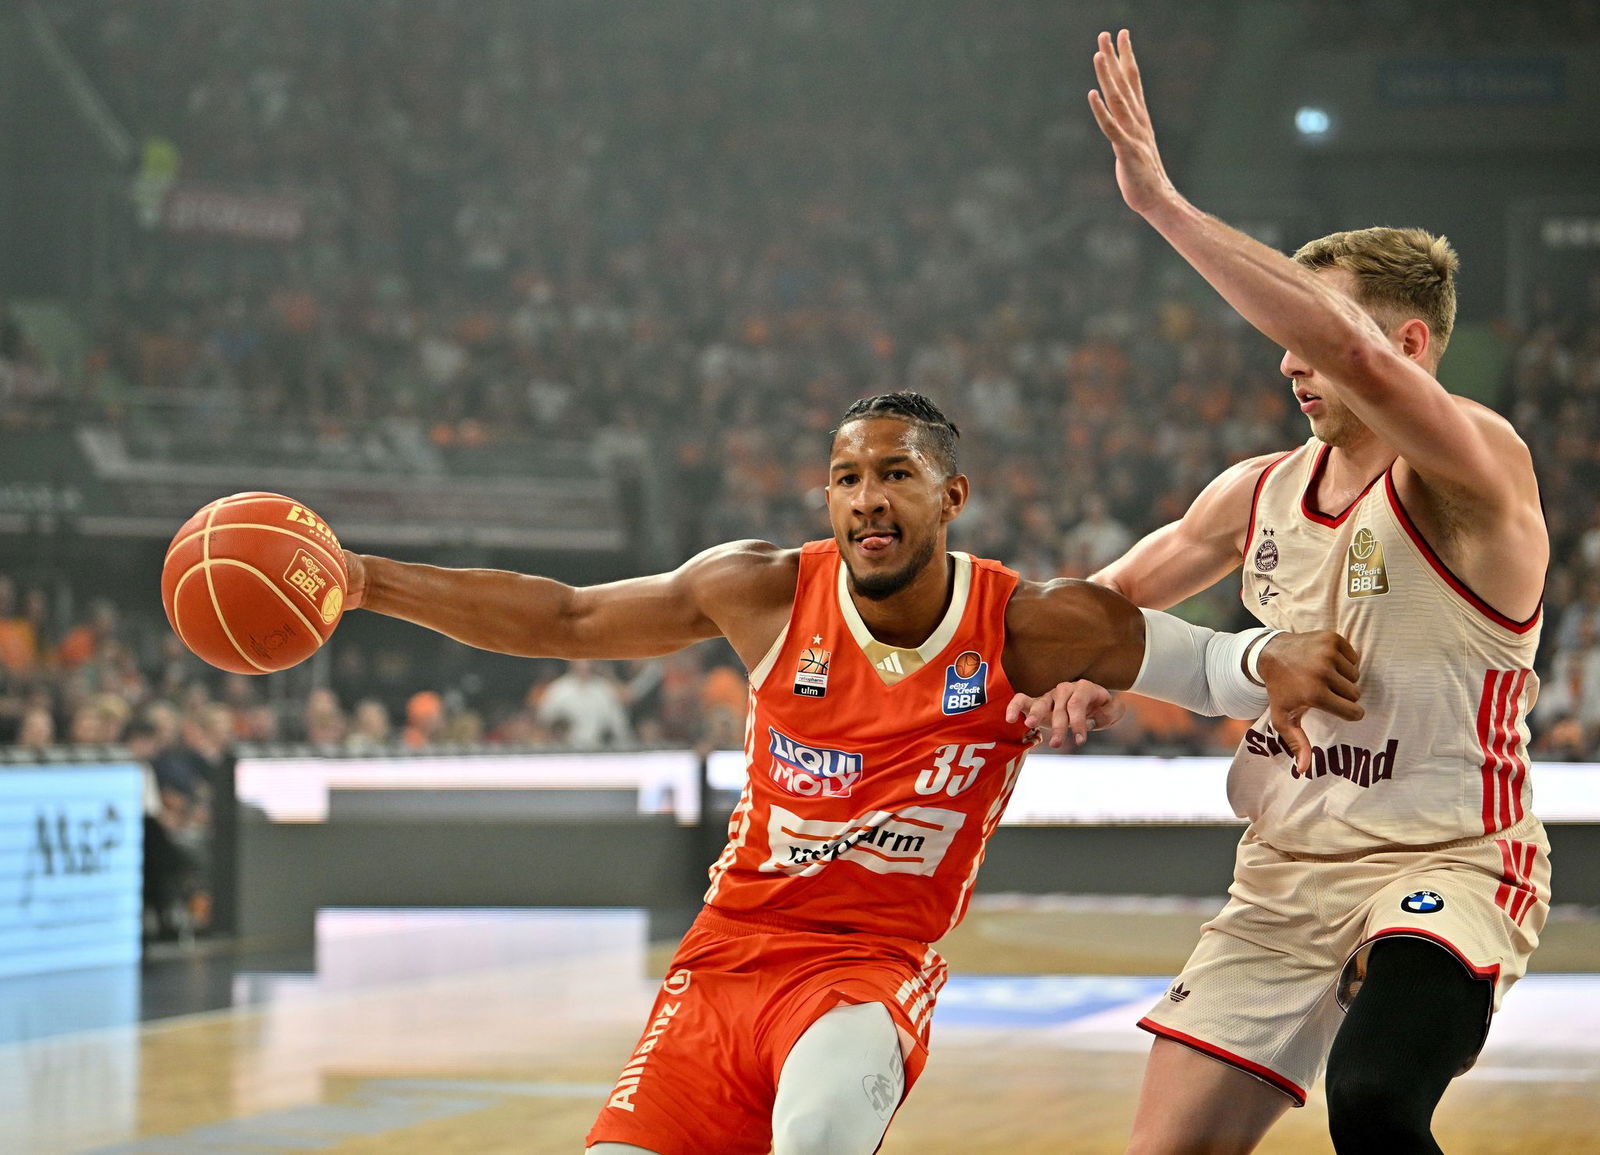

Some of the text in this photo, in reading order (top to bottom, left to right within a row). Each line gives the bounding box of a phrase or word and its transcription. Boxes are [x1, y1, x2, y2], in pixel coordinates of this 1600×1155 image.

[301, 556, 320, 573] easy
[1358, 567, 1382, 577] Credit
[290, 568, 320, 601] BBL
[307, 568, 327, 588] Credit
[1351, 576, 1384, 593] BBL
[801, 687, 818, 696] ulm
[949, 682, 969, 690] easy
[957, 686, 981, 695] Credit
[947, 694, 981, 709] BBL
[773, 732, 856, 777] LIQUI
[914, 741, 997, 797] 35
[773, 760, 860, 797] MOLY
[1408, 891, 1442, 901] BMW
[606, 1001, 682, 1113] Allianz
